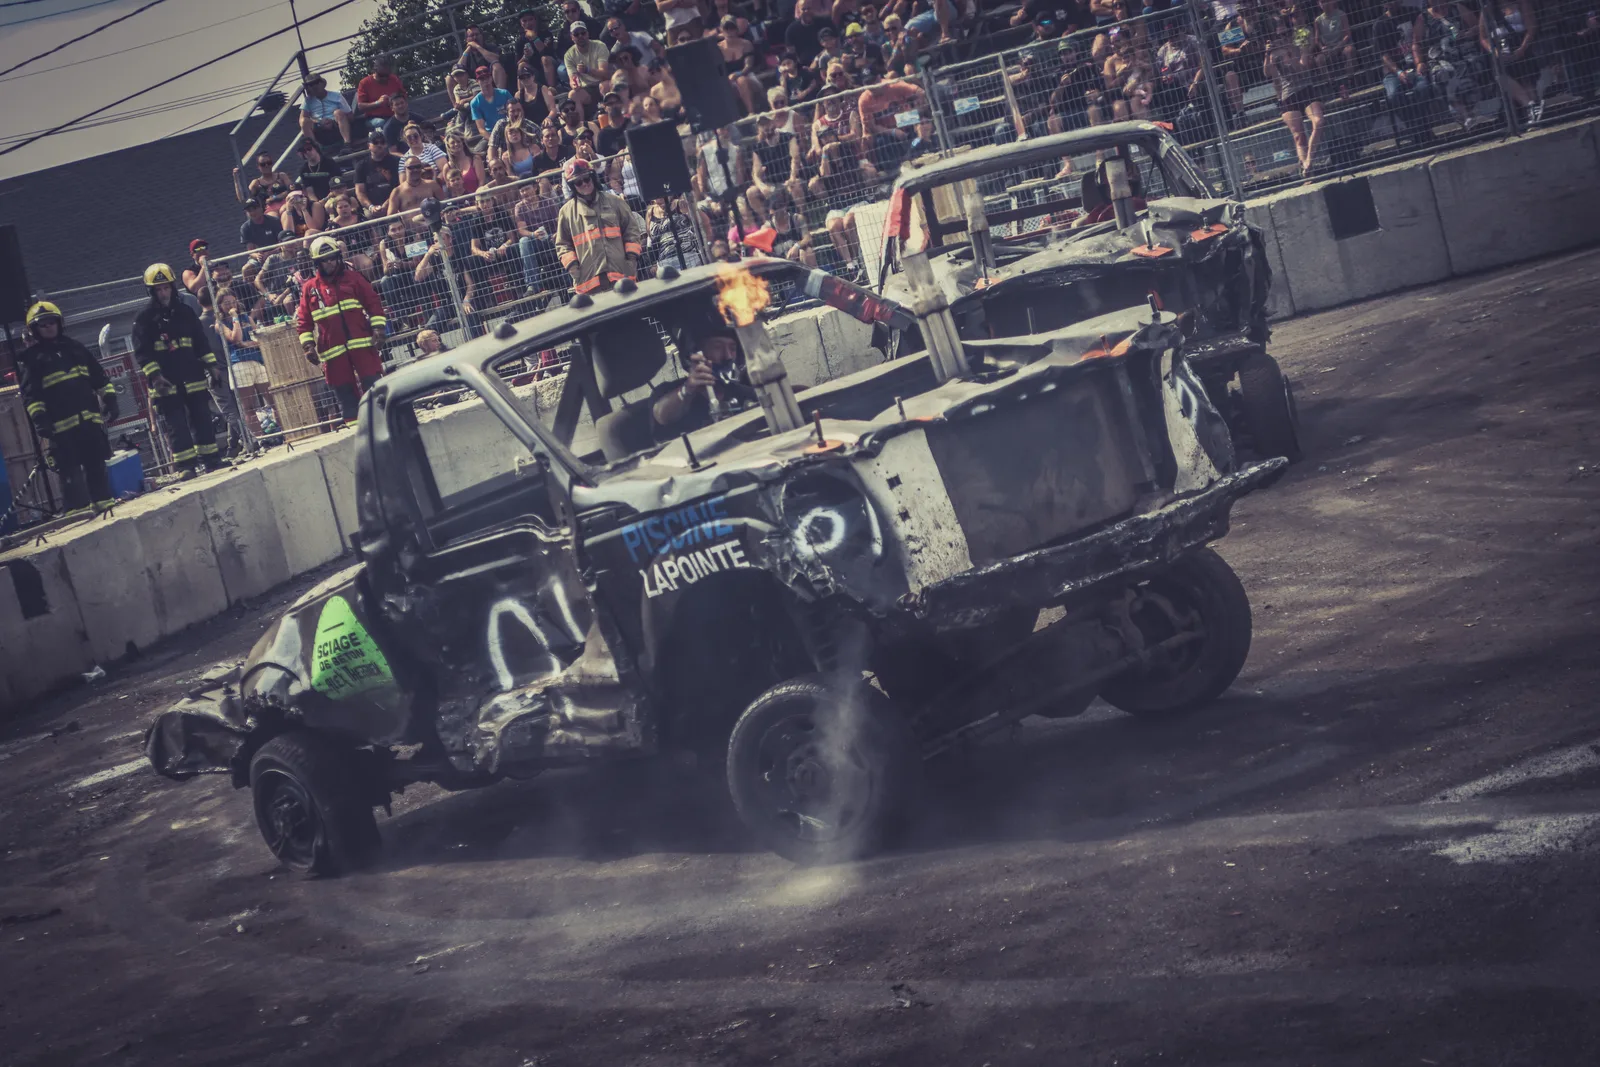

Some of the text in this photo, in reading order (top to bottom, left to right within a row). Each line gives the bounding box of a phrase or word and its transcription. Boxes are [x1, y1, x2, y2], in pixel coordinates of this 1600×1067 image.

[621, 496, 734, 563] PISCINE
[639, 539, 750, 598] LAPOINTE
[317, 632, 361, 659] SCIAGE
[319, 660, 331, 671] DE
